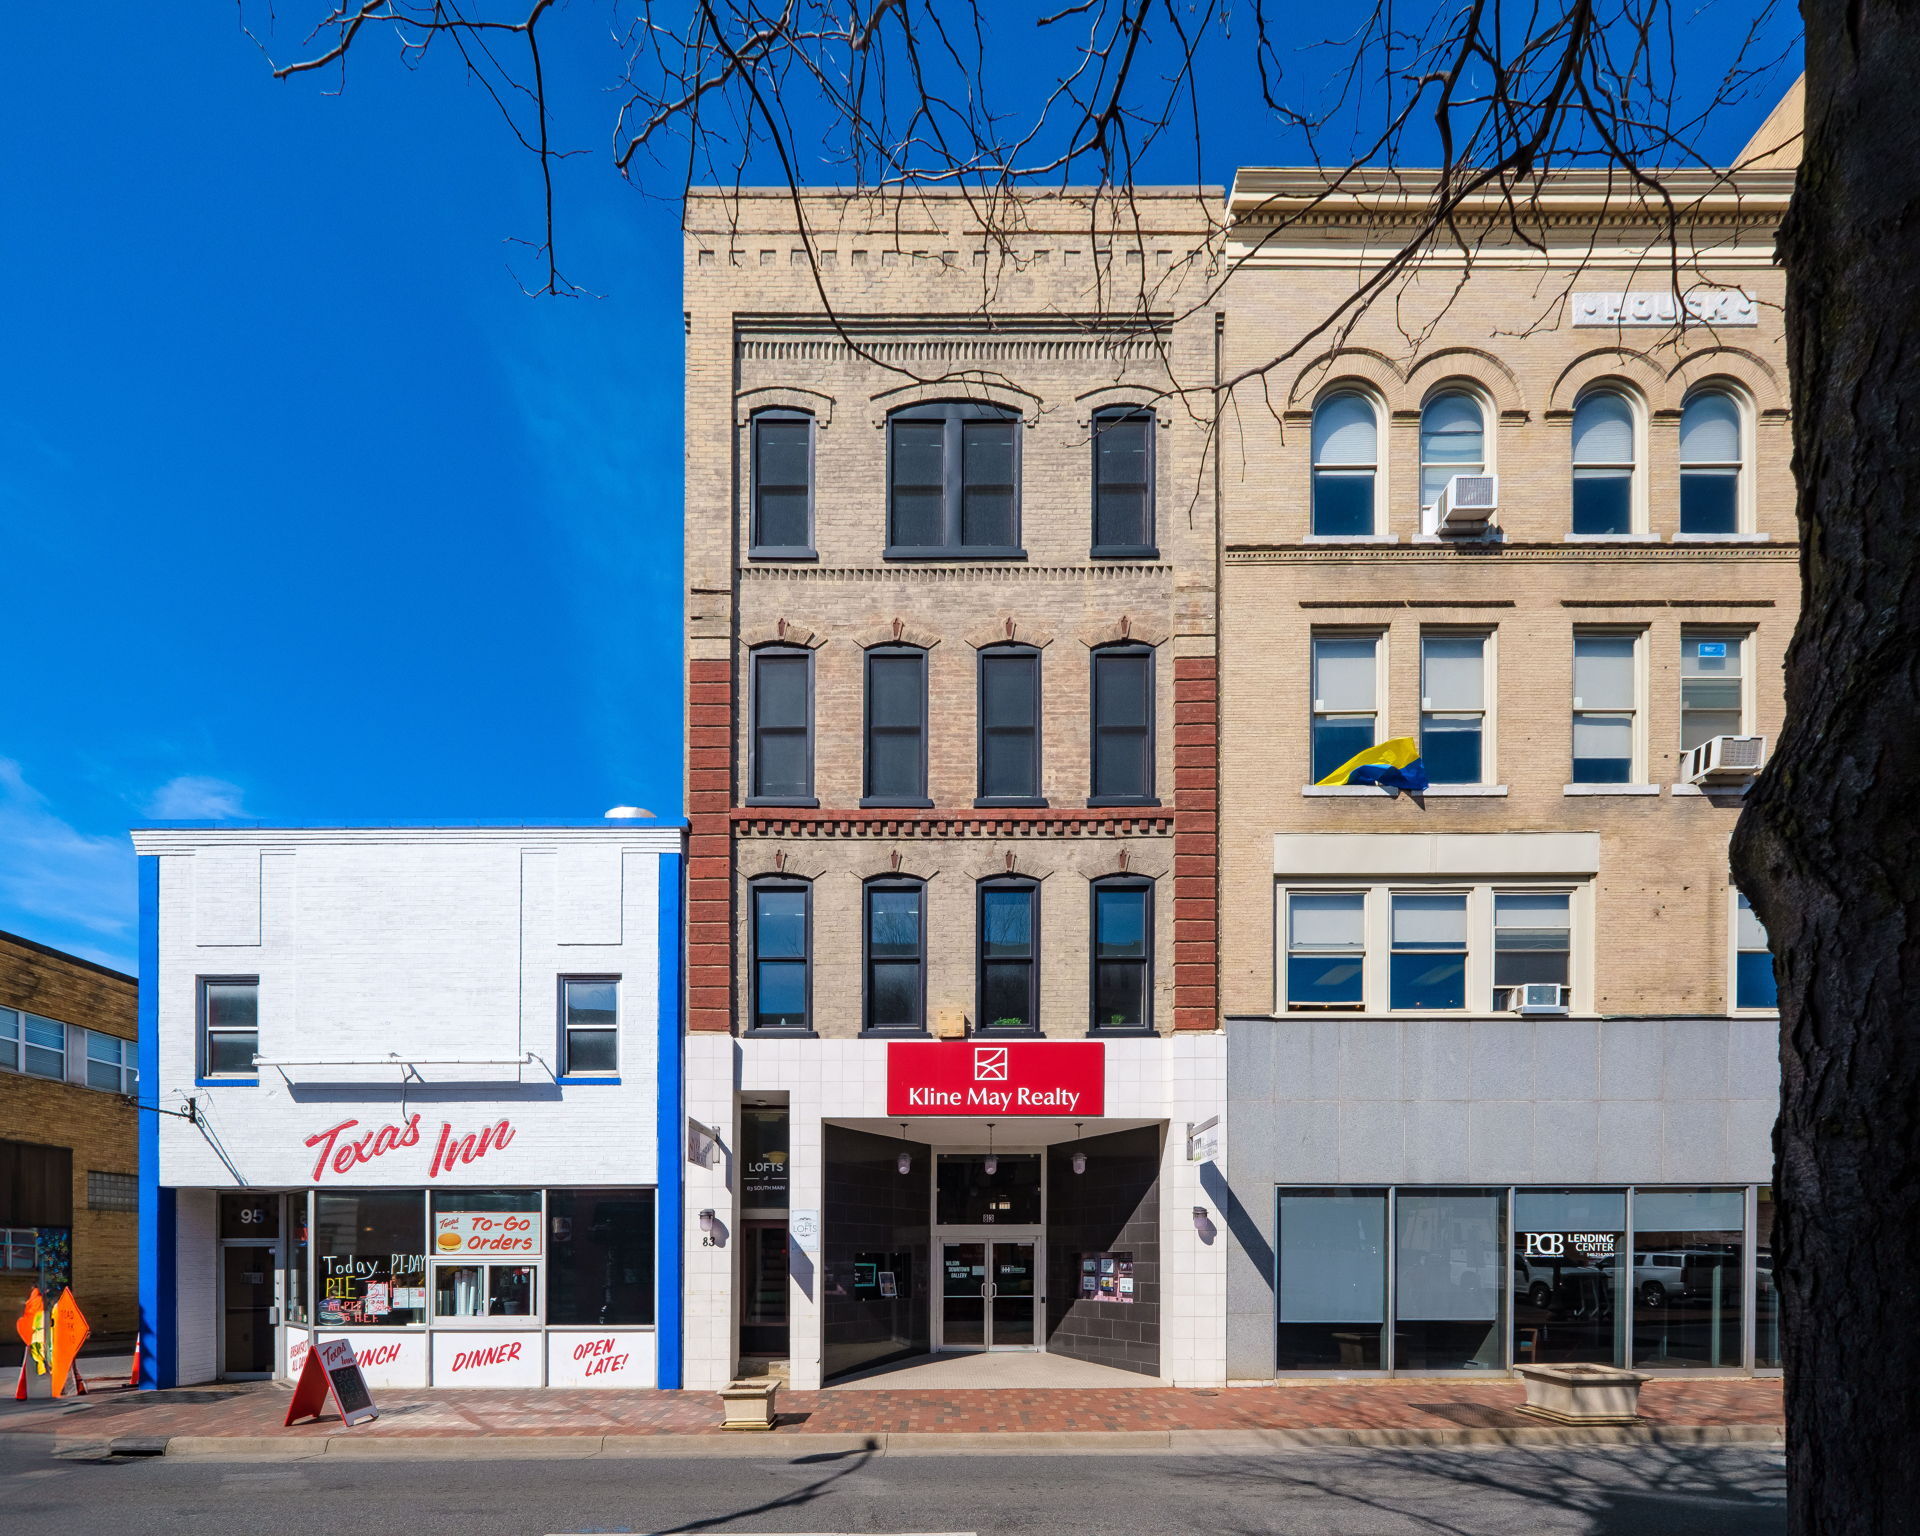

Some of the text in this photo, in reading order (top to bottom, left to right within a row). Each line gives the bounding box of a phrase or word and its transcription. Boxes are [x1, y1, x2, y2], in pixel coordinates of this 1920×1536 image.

[909, 1087, 1080, 1112] Kline May Realty
[303, 1112, 516, 1182] Texas Inn
[748, 1162, 784, 1172] LOFTS
[240, 1208, 264, 1224] 95
[472, 1216, 531, 1231] To-Go
[793, 1224, 818, 1233] LOFTS
[1567, 1233, 1615, 1243] LENDING
[467, 1233, 533, 1250] Orders
[702, 1236, 716, 1247] 83
[1524, 1233, 1565, 1254] PCB
[1575, 1243, 1615, 1252] CENTER
[326, 1275, 357, 1299] PIE
[322, 1342, 347, 1366] Texas
[354, 1343, 402, 1368] UNCH
[452, 1342, 522, 1372] DINNER
[573, 1338, 616, 1361] OPEN
[585, 1353, 629, 1377] LATE!
